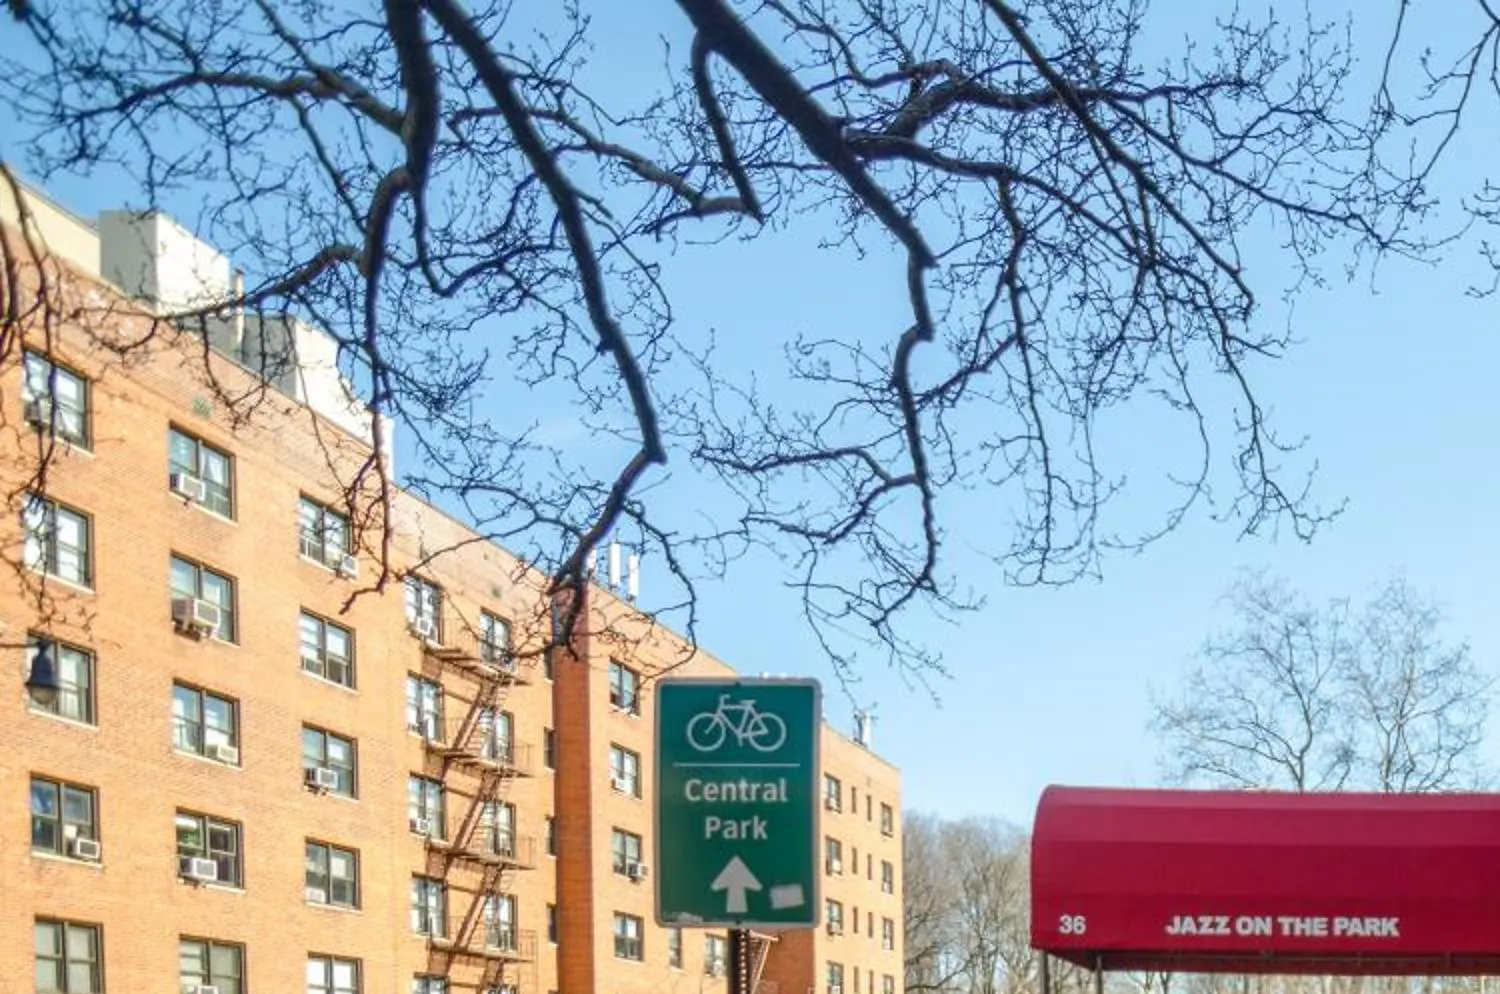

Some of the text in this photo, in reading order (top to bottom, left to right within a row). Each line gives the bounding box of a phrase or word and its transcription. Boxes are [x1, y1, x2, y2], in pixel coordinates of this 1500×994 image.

[684, 778, 788, 802] Central
[704, 816, 768, 840] Park
[1058, 915, 1087, 935] 36
[1165, 915, 1400, 937] JAZZ ON THE PARK
